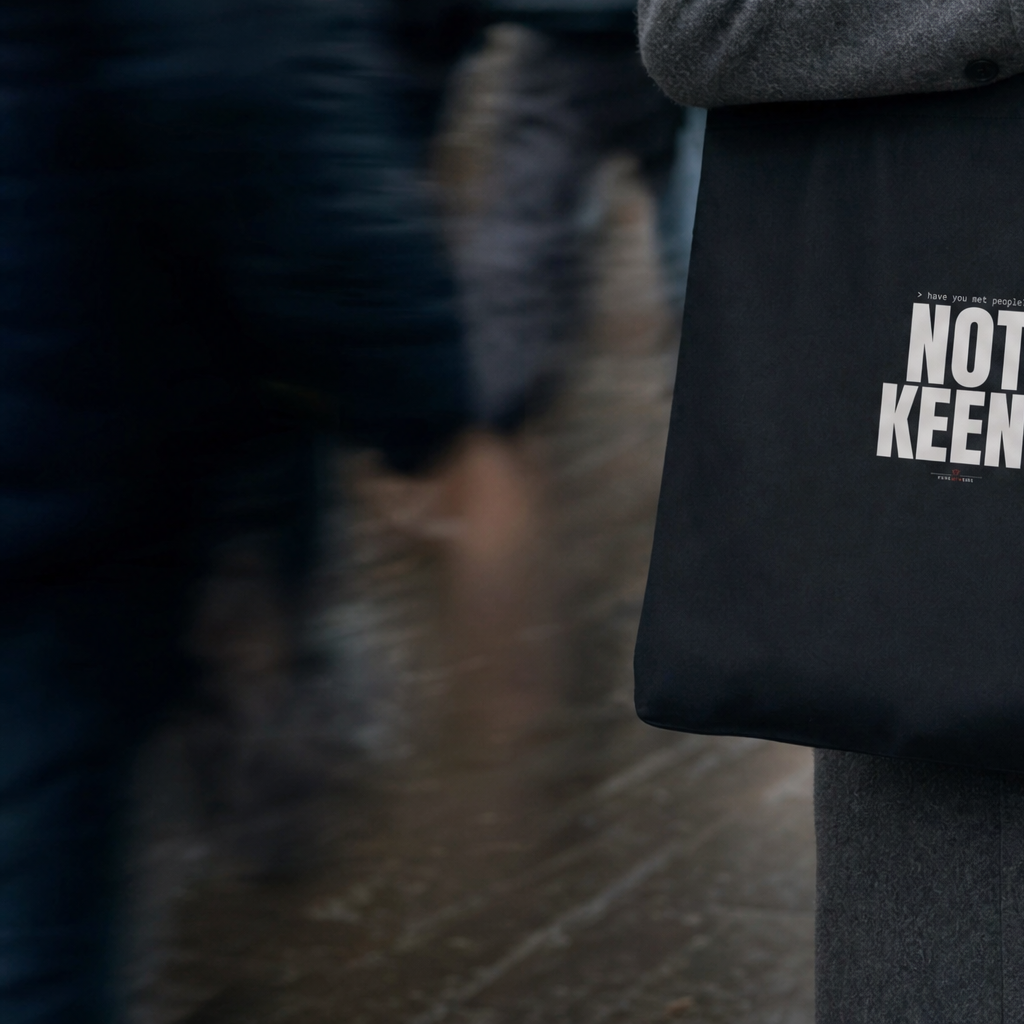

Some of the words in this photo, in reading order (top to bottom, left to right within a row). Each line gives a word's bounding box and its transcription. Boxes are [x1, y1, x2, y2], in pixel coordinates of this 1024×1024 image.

[927, 291, 948, 301] have
[952, 295, 968, 304] you
[971, 295, 987, 304] met
